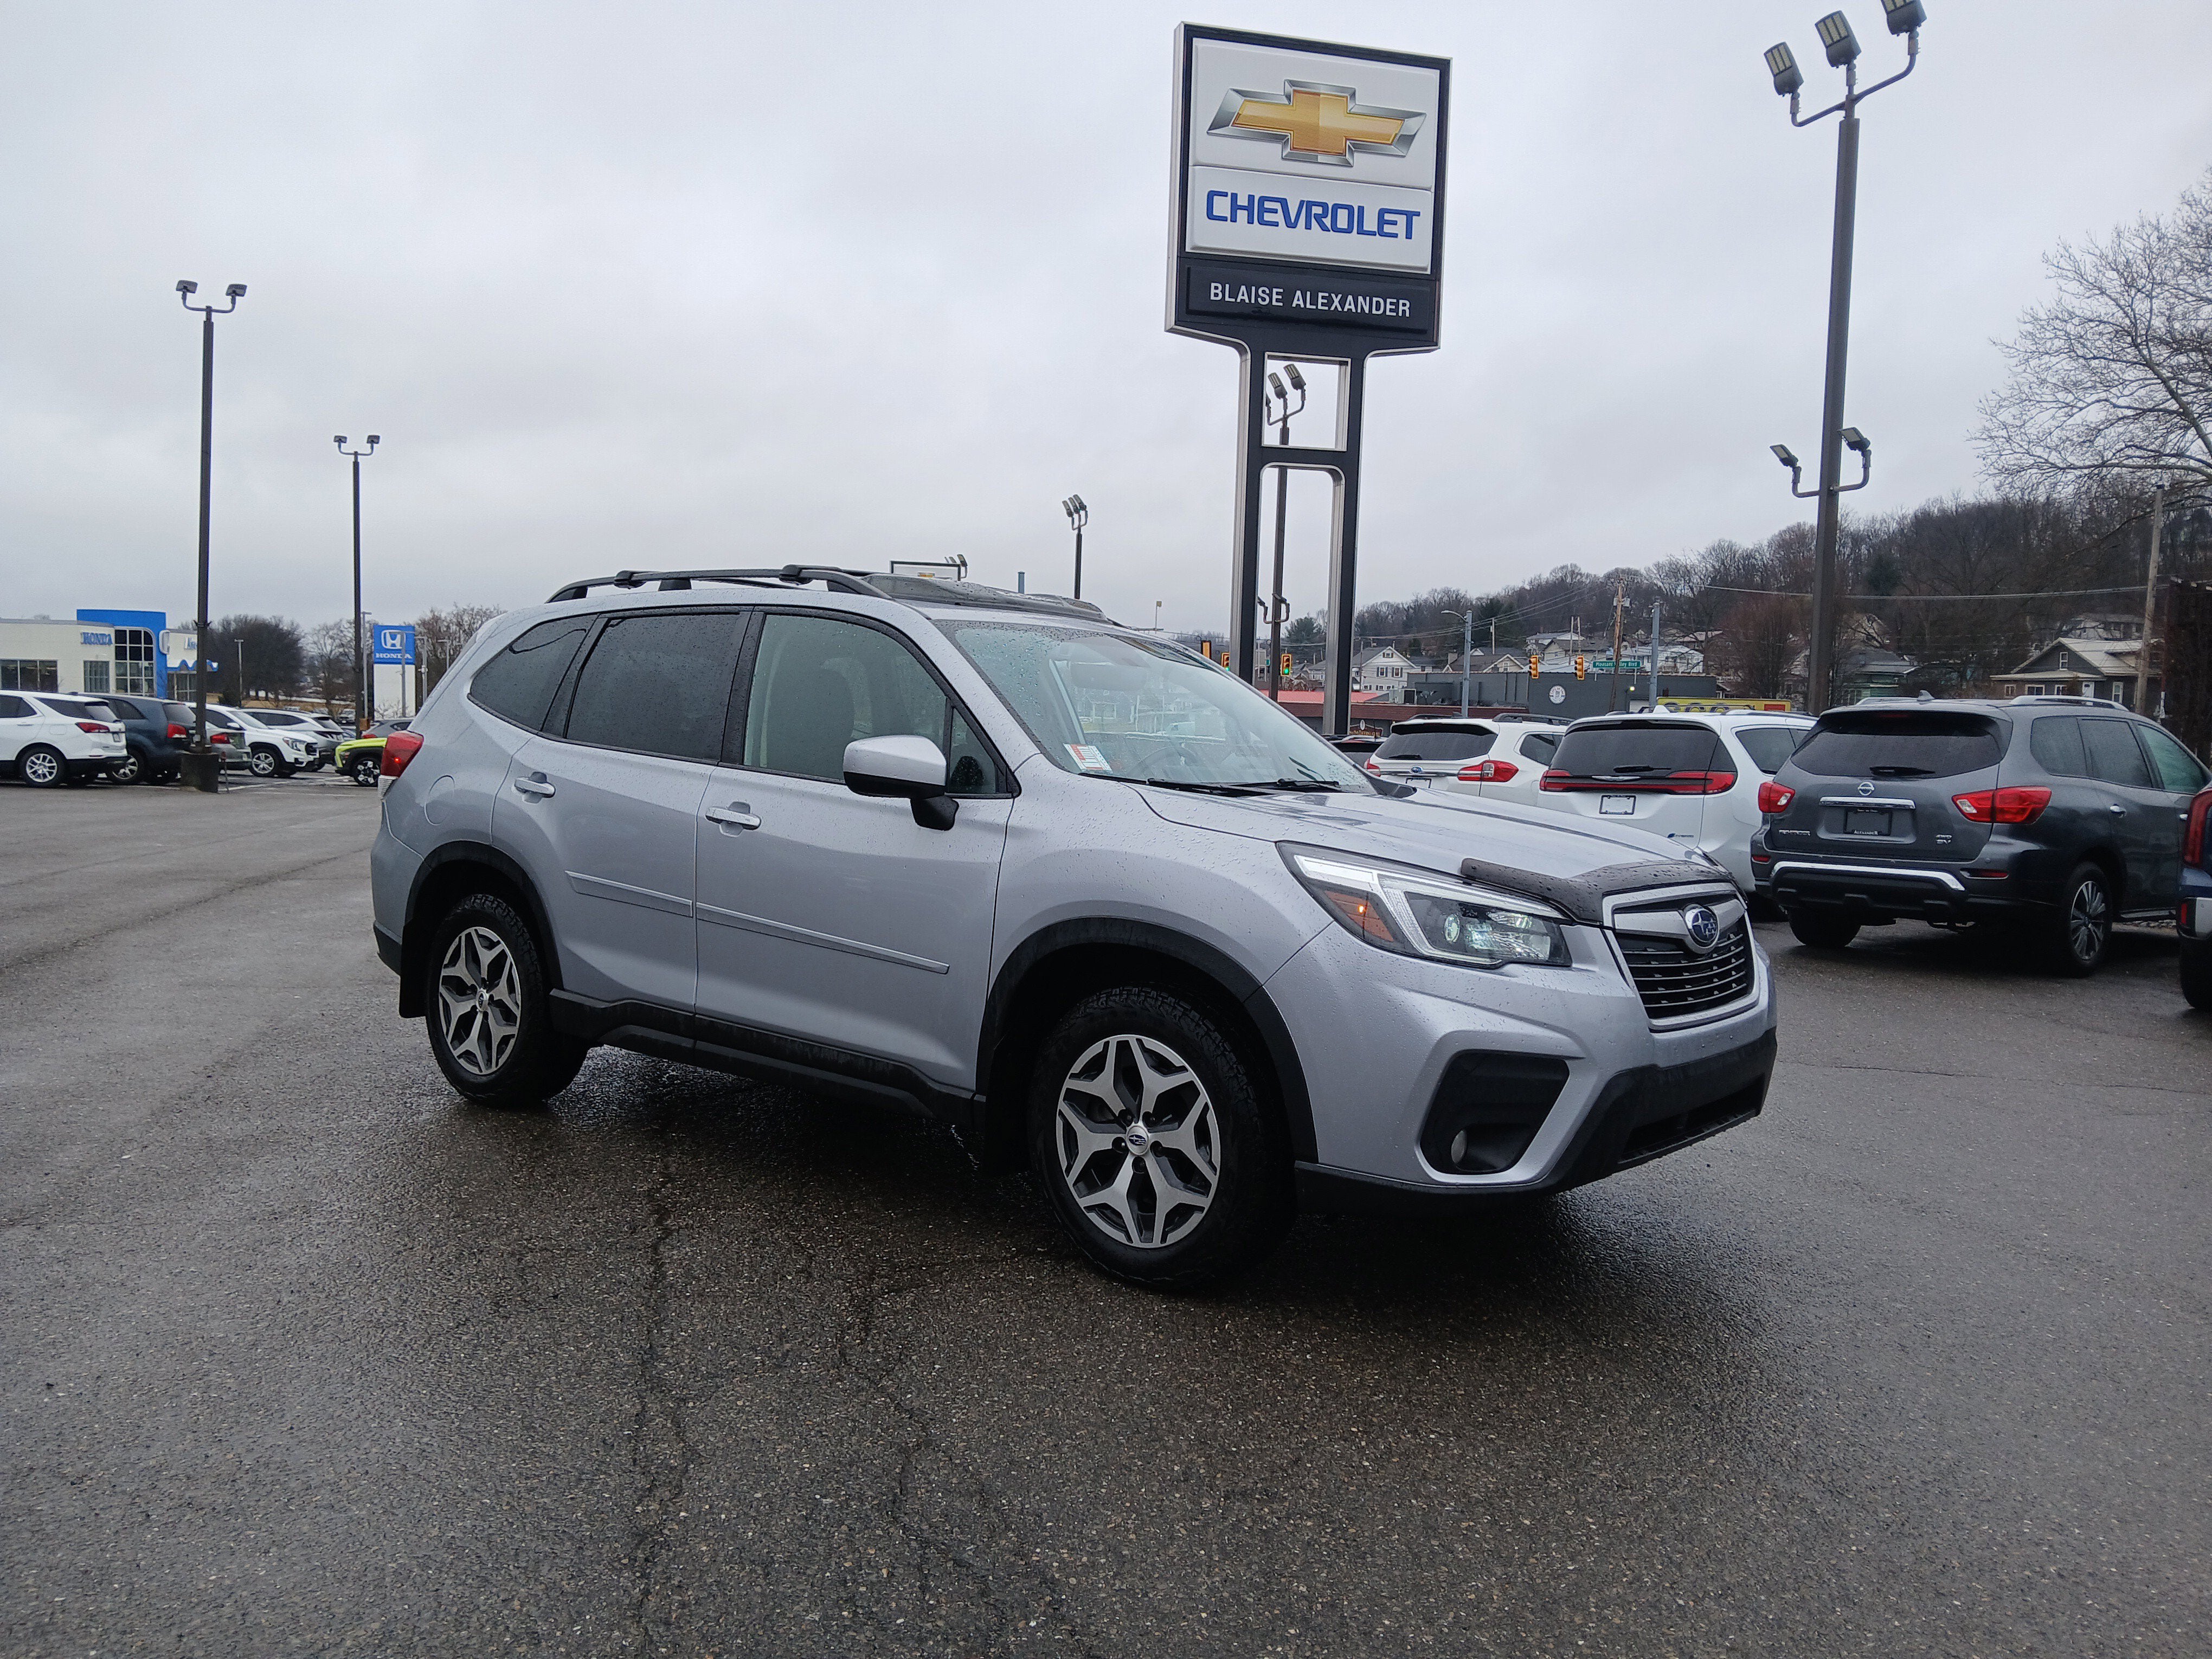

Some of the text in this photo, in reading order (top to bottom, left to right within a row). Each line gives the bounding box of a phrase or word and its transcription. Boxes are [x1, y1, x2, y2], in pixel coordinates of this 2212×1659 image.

[1206, 190, 1421, 240] CHEVROLET
[1210, 282, 1411, 317] BLAISE ALEXANDER
